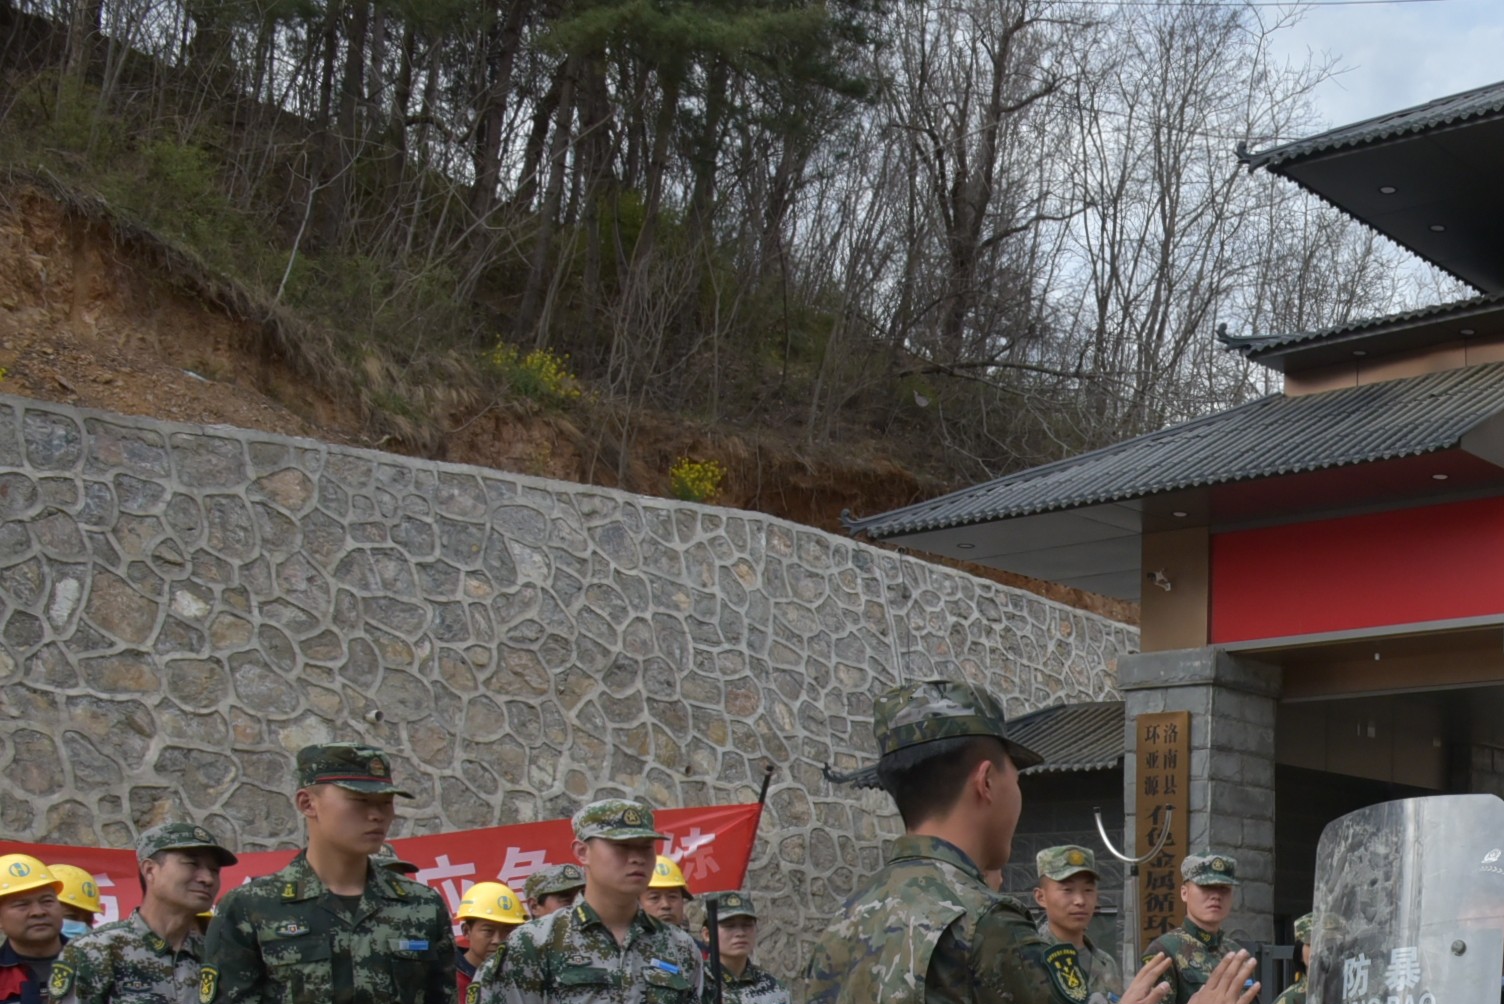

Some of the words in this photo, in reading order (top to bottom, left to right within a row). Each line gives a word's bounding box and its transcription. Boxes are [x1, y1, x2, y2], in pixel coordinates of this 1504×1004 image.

[1163, 723, 1179, 796] 洛南县
[1343, 946, 1421, 999] 防暴
